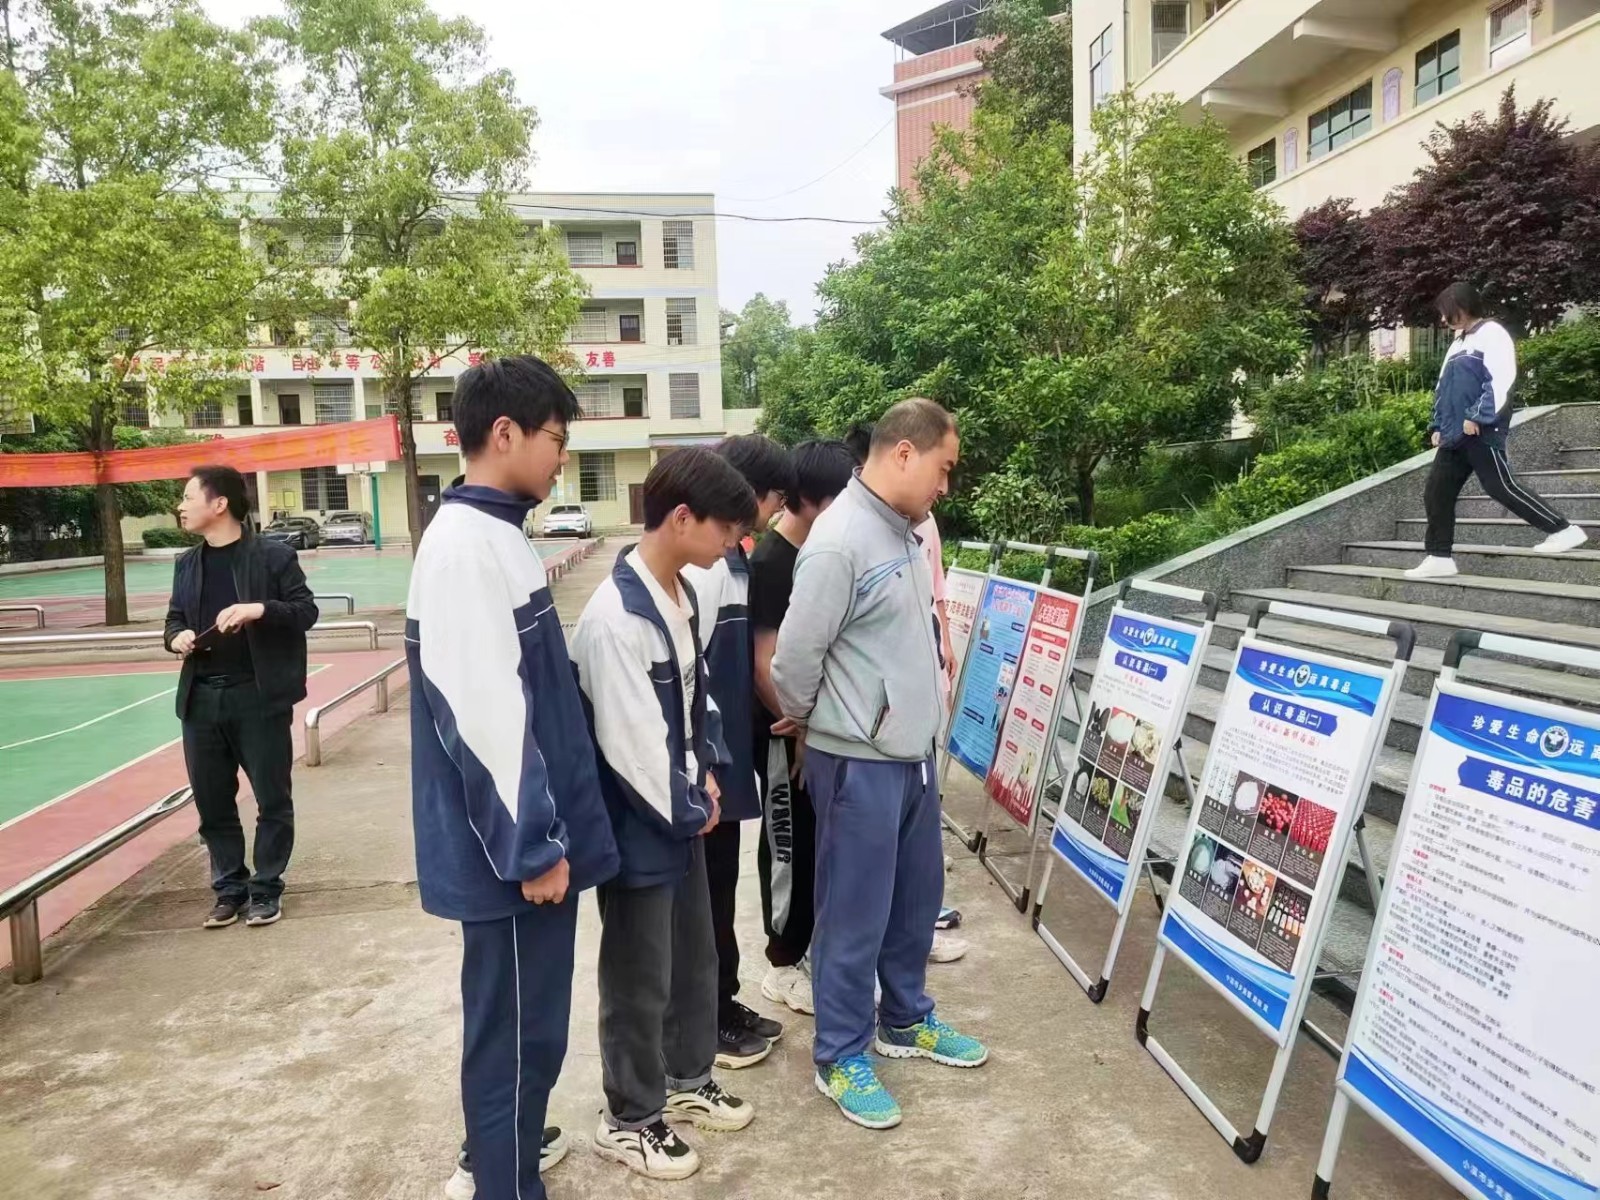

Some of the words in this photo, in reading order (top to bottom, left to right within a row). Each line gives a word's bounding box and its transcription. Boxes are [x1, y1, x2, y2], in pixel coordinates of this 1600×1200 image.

[292, 354, 321, 372] 自由
[586, 351, 616, 368] 友善
[1259, 660, 1294, 679] 珍爱生命
[1308, 672, 1351, 694] 远离毒品
[1471, 714, 1540, 744] 珍爱生命
[1485, 769, 1598, 821] 毒品的危害
